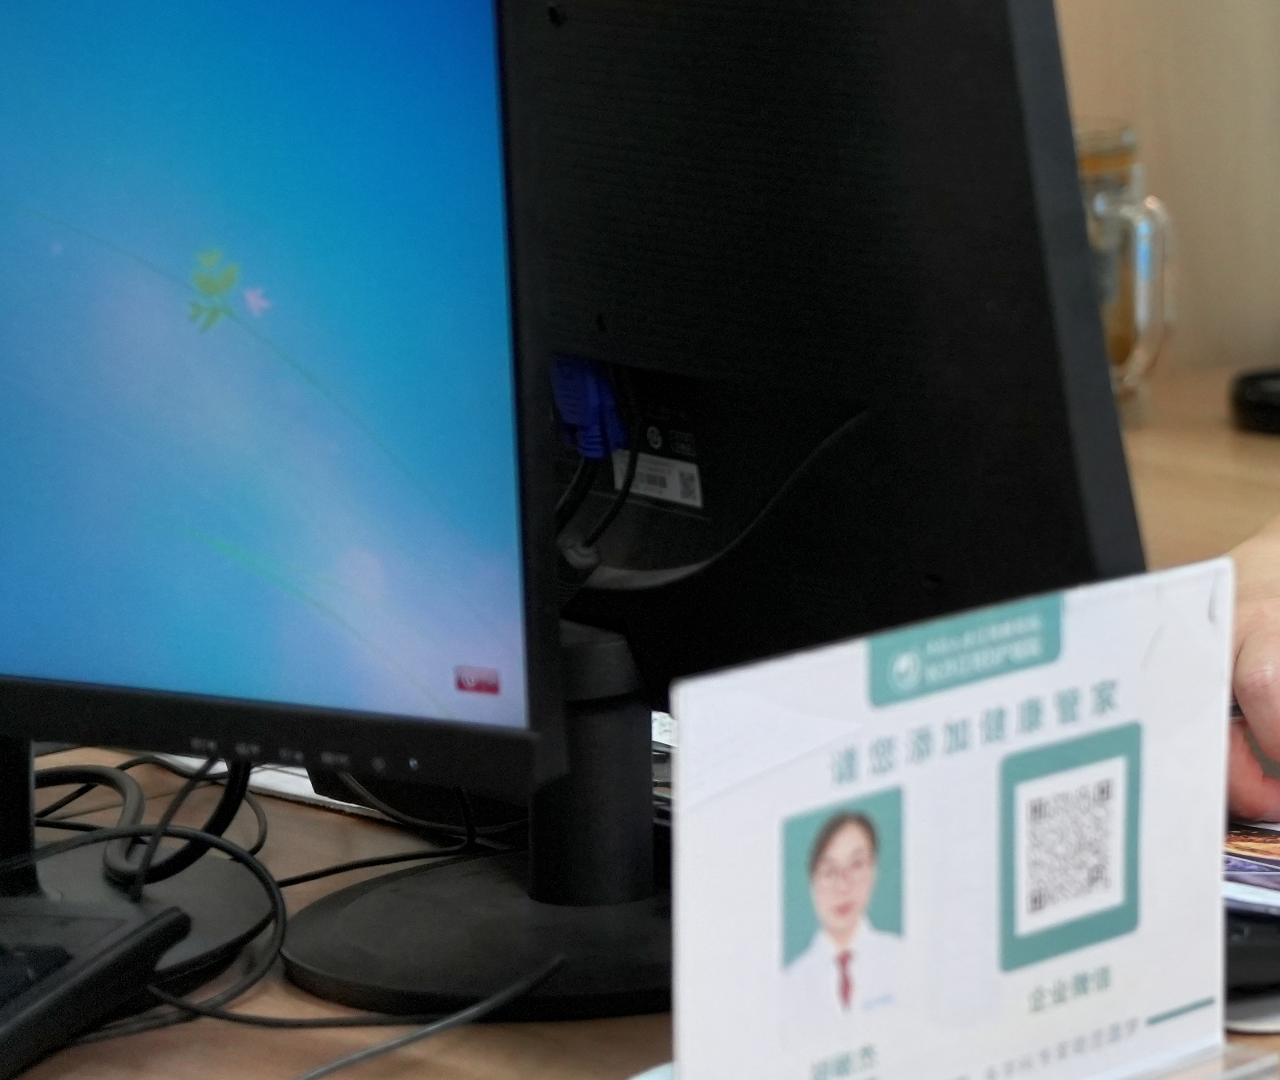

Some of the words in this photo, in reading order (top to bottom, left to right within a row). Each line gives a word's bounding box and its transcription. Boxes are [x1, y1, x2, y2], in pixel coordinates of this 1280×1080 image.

[832, 681, 1121, 784] 请您添加健康管家
[1027, 965, 1113, 1013] 企业微信
